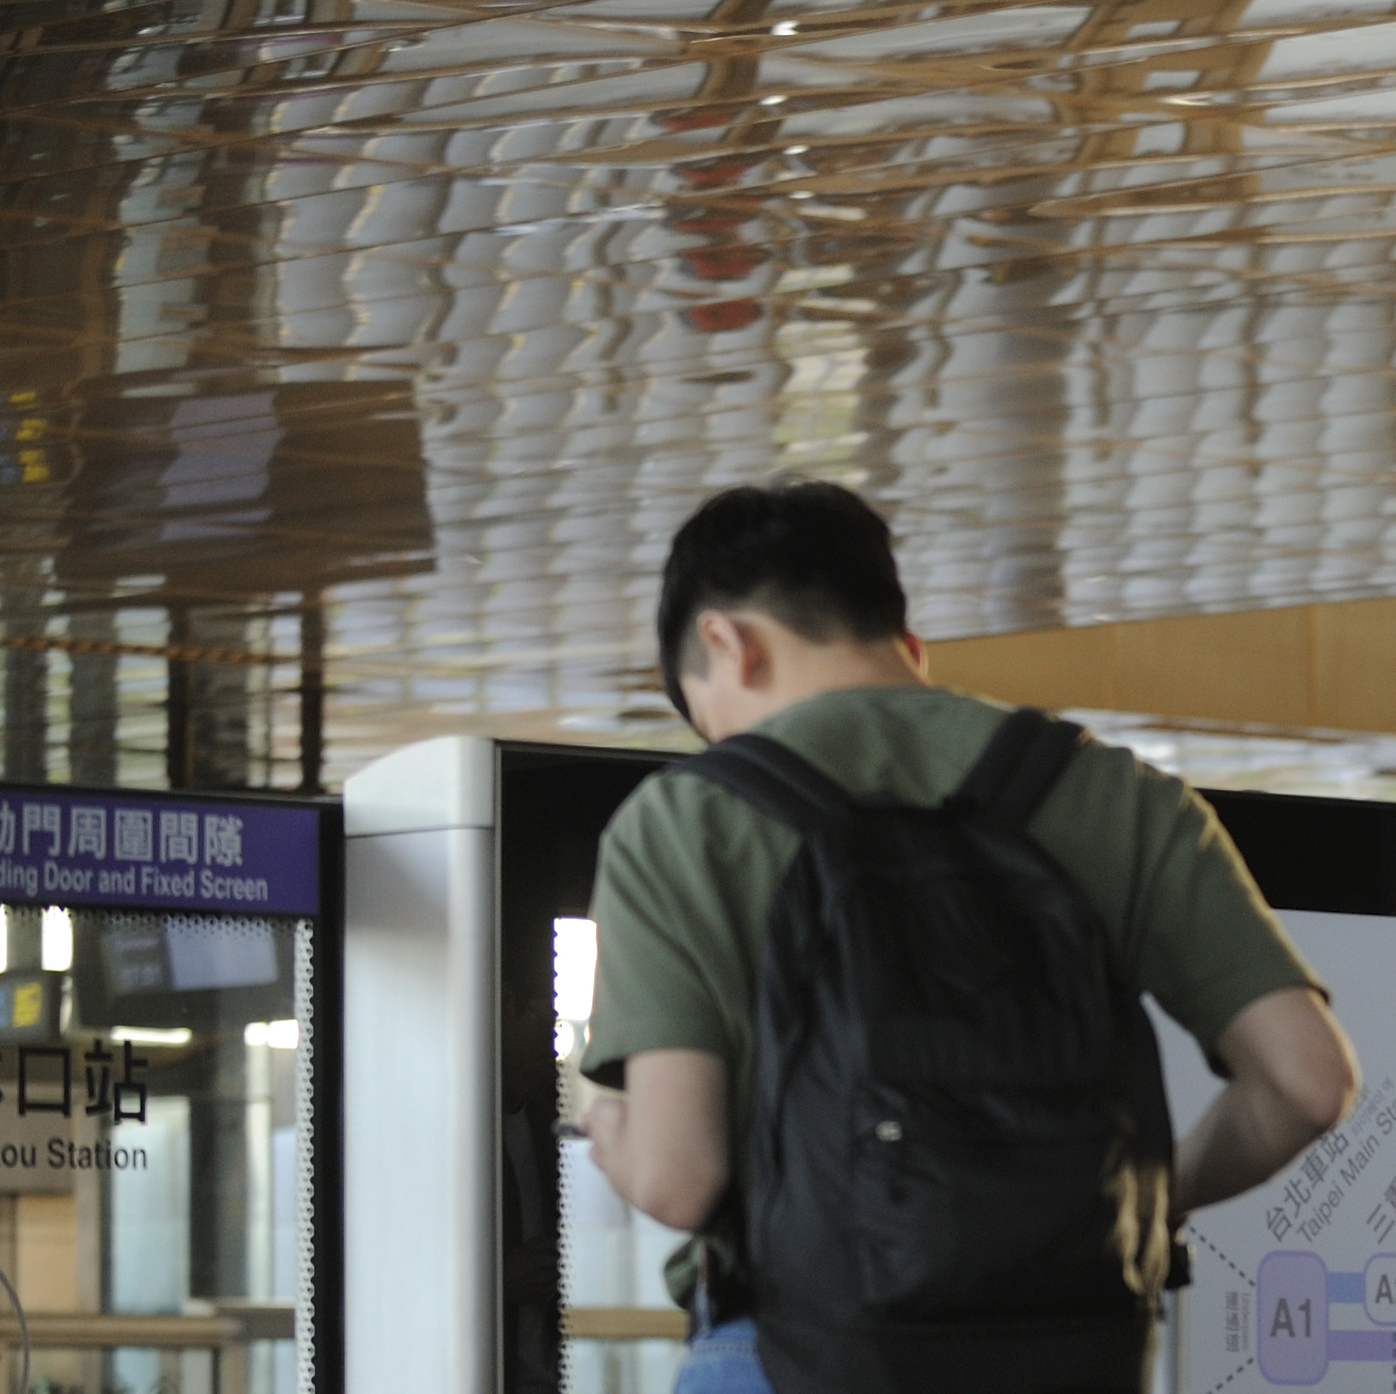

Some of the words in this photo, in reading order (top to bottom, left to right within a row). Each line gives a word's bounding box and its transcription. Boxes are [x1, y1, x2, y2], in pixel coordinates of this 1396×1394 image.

[44, 860, 93, 893] Door
[98, 866, 136, 895] and
[141, 866, 196, 899] Fixed
[201, 869, 268, 901] Screen
[0, 1039, 148, 1124] 口站
[0, 1142, 36, 1168] ou
[47, 1137, 148, 1170] Station
[1266, 1131, 1349, 1242] 台北車站
[1296, 1179, 1344, 1243] Taipei
[1340, 1134, 1380, 1186] Main
[1270, 1297, 1312, 1338] A1
